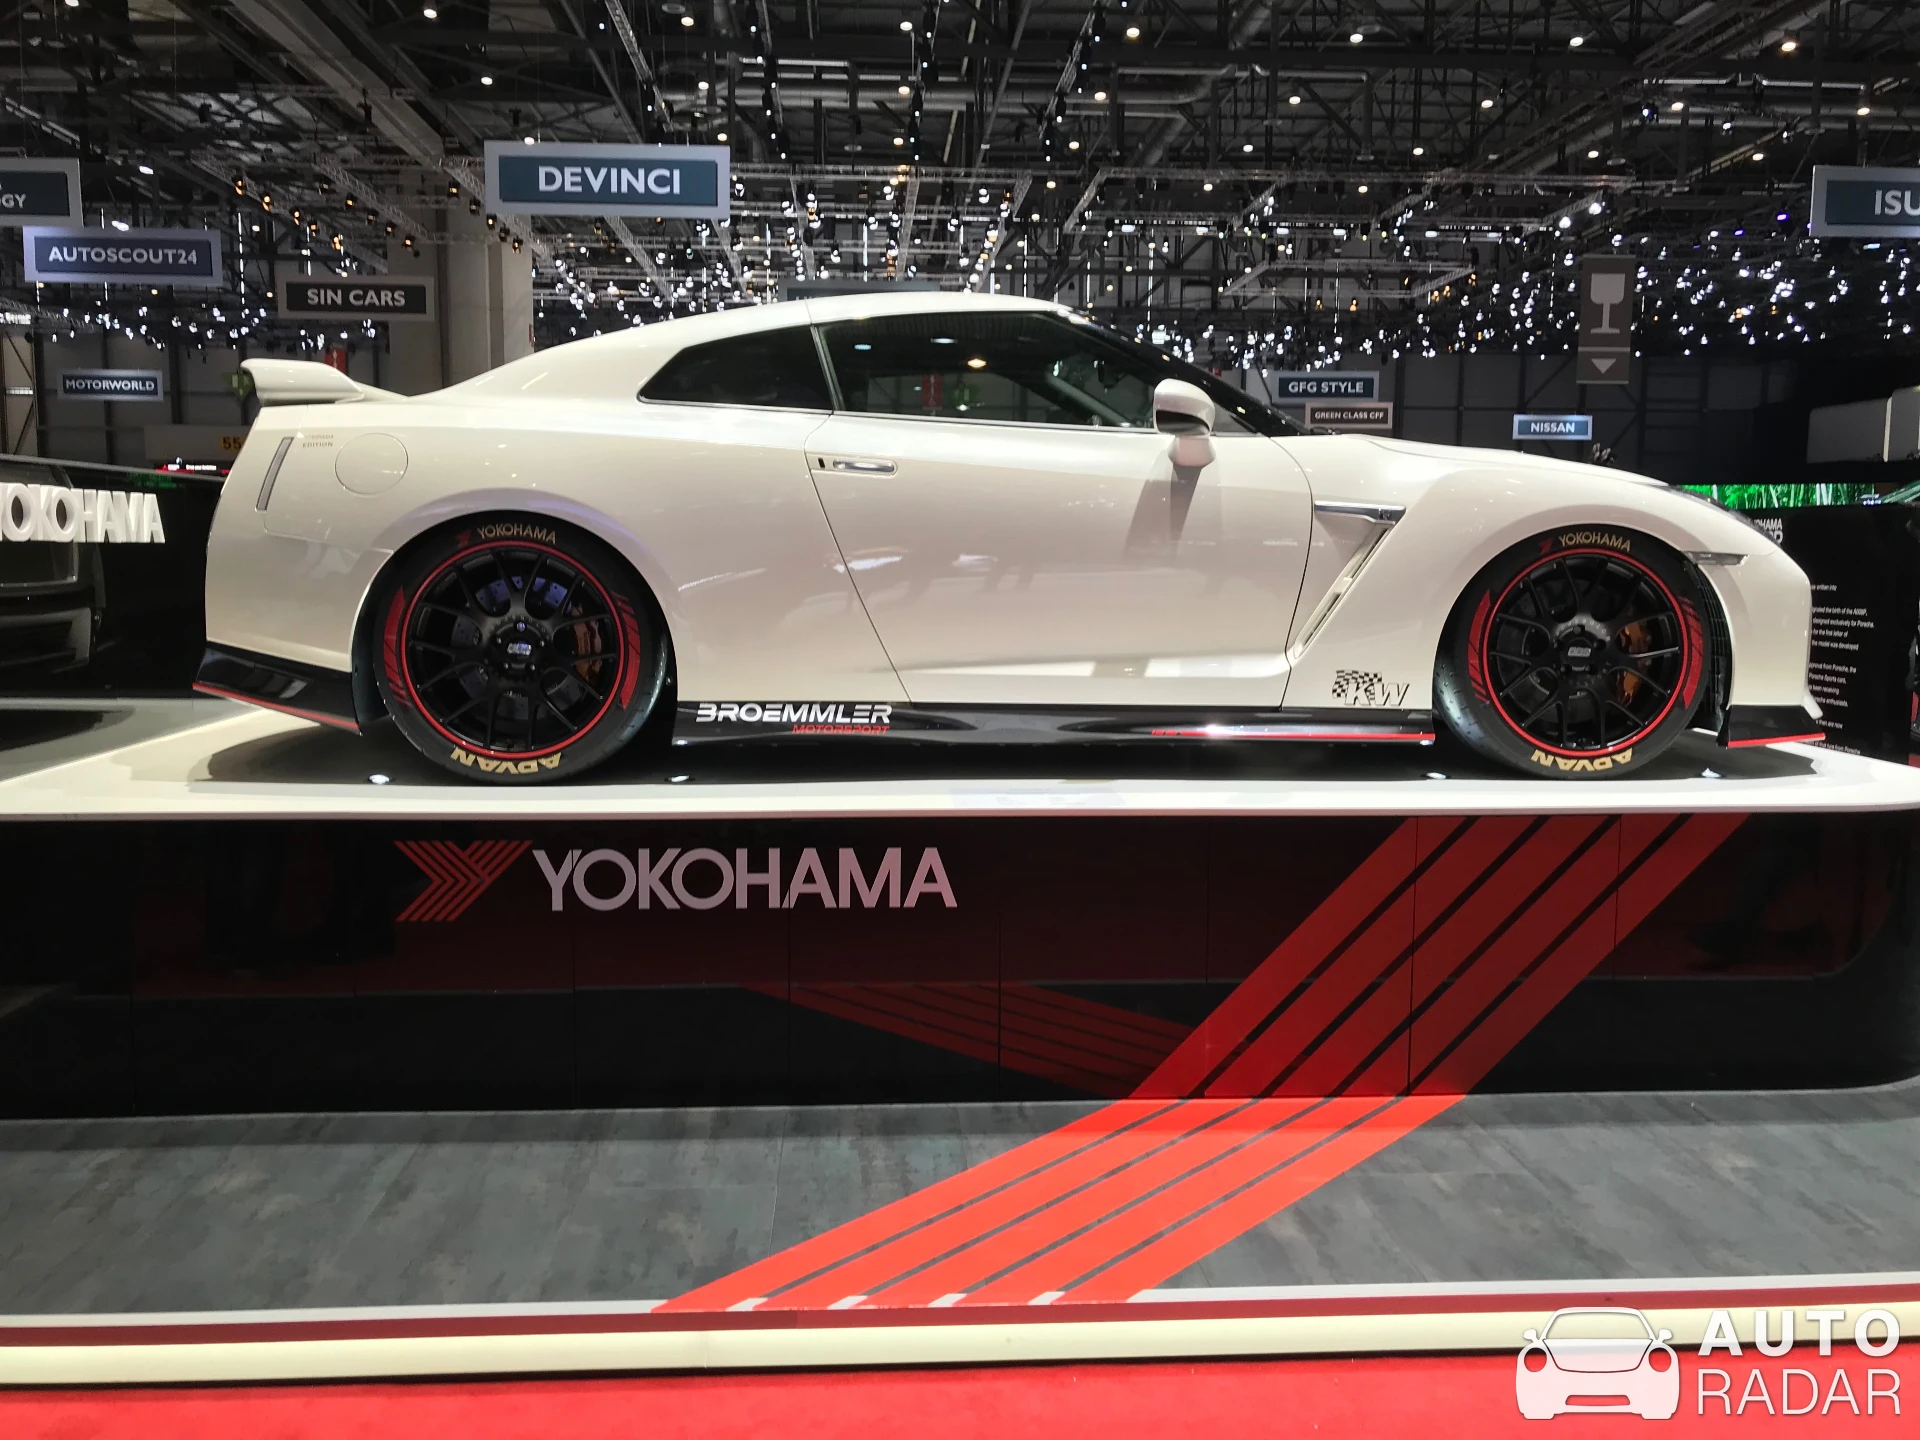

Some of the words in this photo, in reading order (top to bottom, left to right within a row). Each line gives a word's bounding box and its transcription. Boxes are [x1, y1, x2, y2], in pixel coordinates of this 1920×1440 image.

[538, 166, 681, 195] DEVINCI
[0, 193, 27, 209] GY
[1874, 189, 1920, 216] ISU
[48, 245, 198, 265] AUTOSCOUT24
[307, 288, 342, 306] SIN
[348, 289, 406, 307] CARS
[65, 379, 155, 392] MOTORWORLD
[1288, 381, 1317, 393] GFG
[1321, 381, 1364, 393] STYLE
[1314, 411, 1341, 420] GREEN
[1342, 411, 1368, 420] CLASS
[1530, 422, 1575, 433] NISSAN
[477, 523, 557, 545] YOKOHAMA
[1558, 532, 1632, 552] YOKOHAMA
[1343, 682, 1410, 706] KW
[696, 703, 893, 723] BROEMMLER
[791, 724, 890, 735] MOTORSPORT
[450, 746, 562, 775] ADVAN
[1531, 748, 1633, 772] ADVAN
[532, 847, 957, 911] YOKOHAMA
